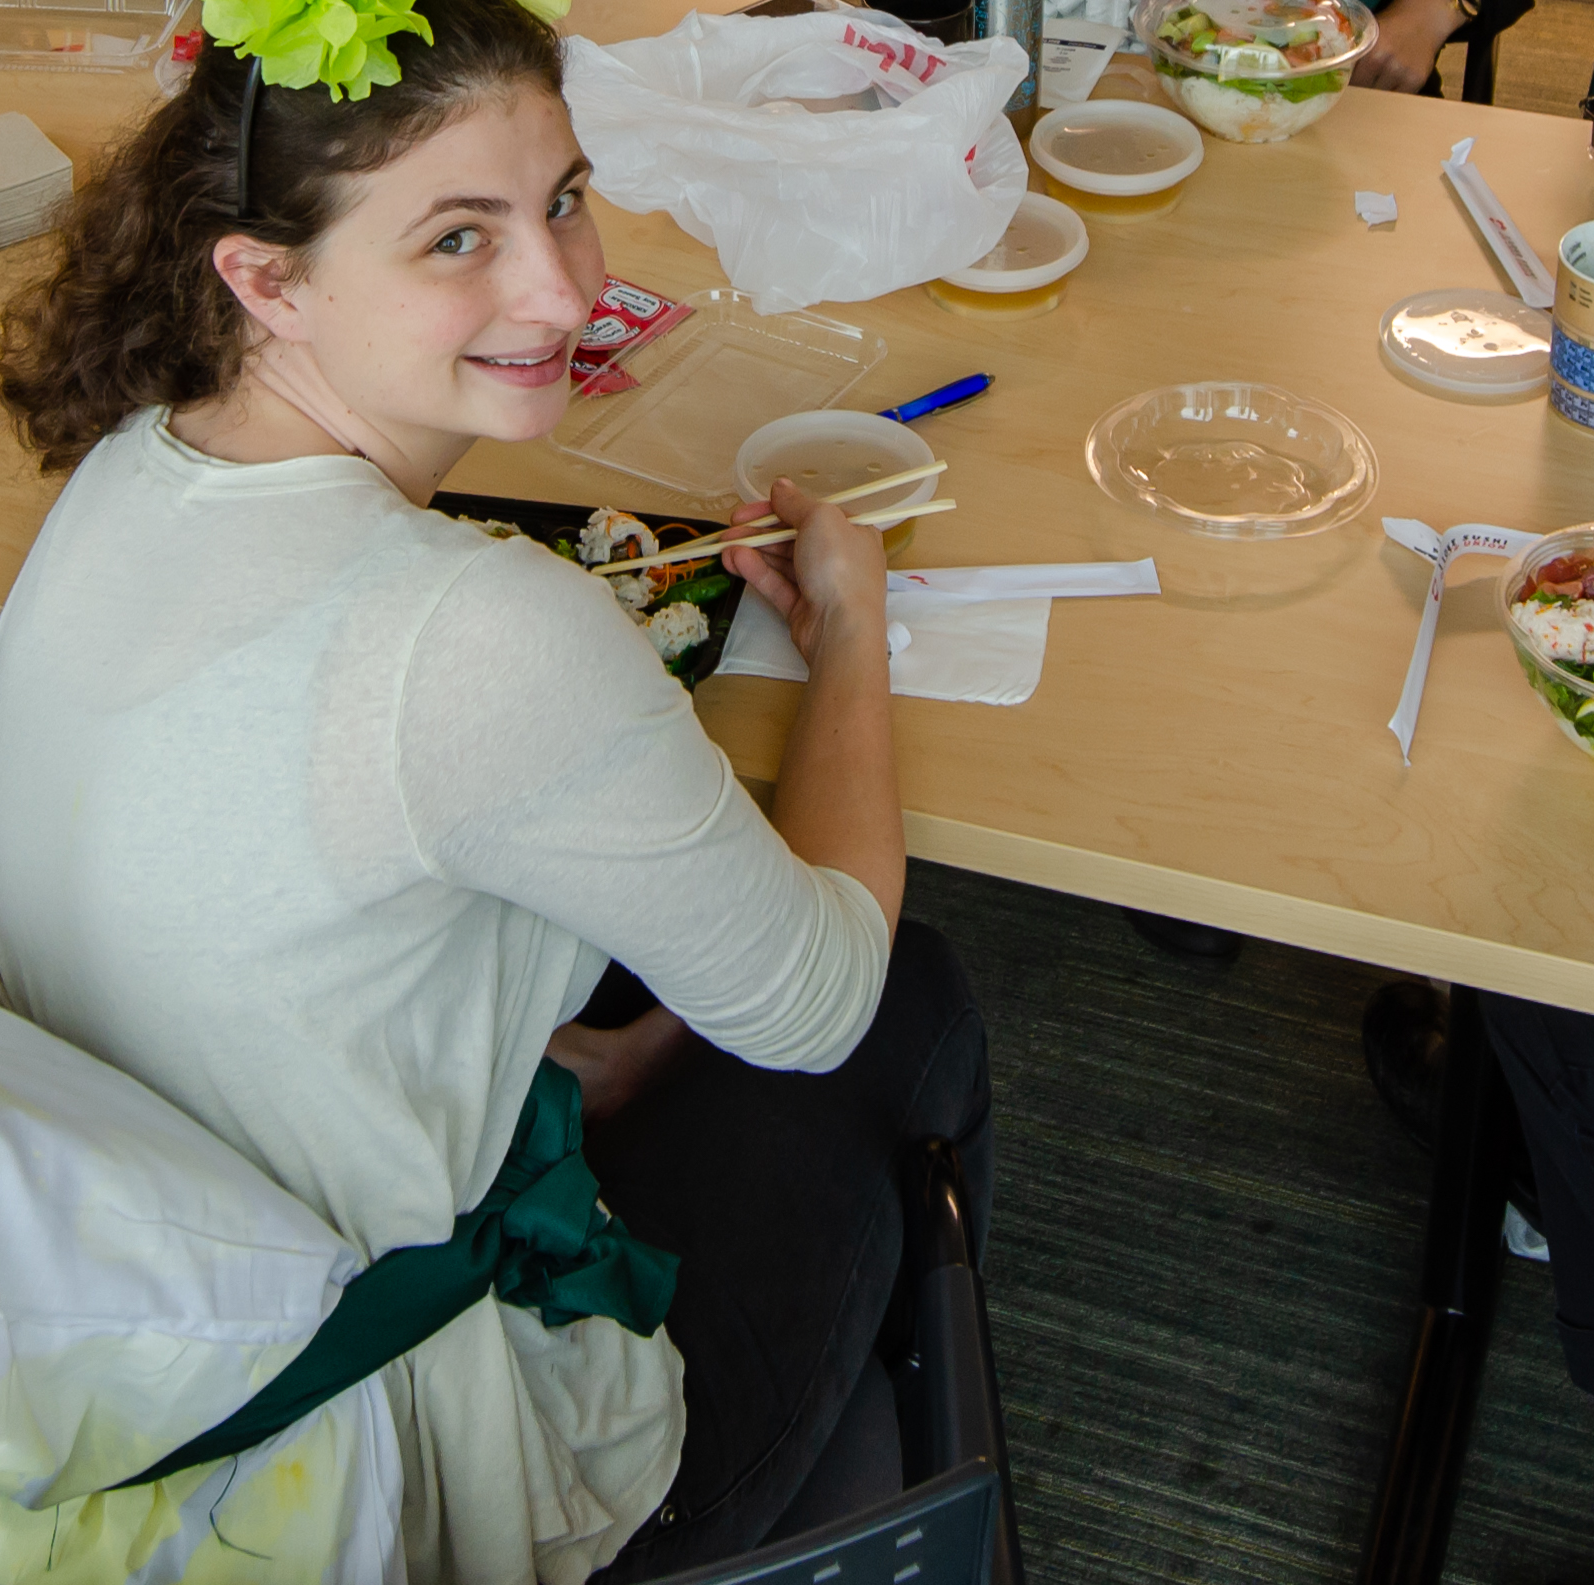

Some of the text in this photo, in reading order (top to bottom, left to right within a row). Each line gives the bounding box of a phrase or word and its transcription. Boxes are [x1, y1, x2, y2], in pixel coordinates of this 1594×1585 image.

[618, 289, 657, 306] Soy Sauce
[1462, 534, 1508, 546] SUSHI
[1462, 539, 1507, 551] UNION
